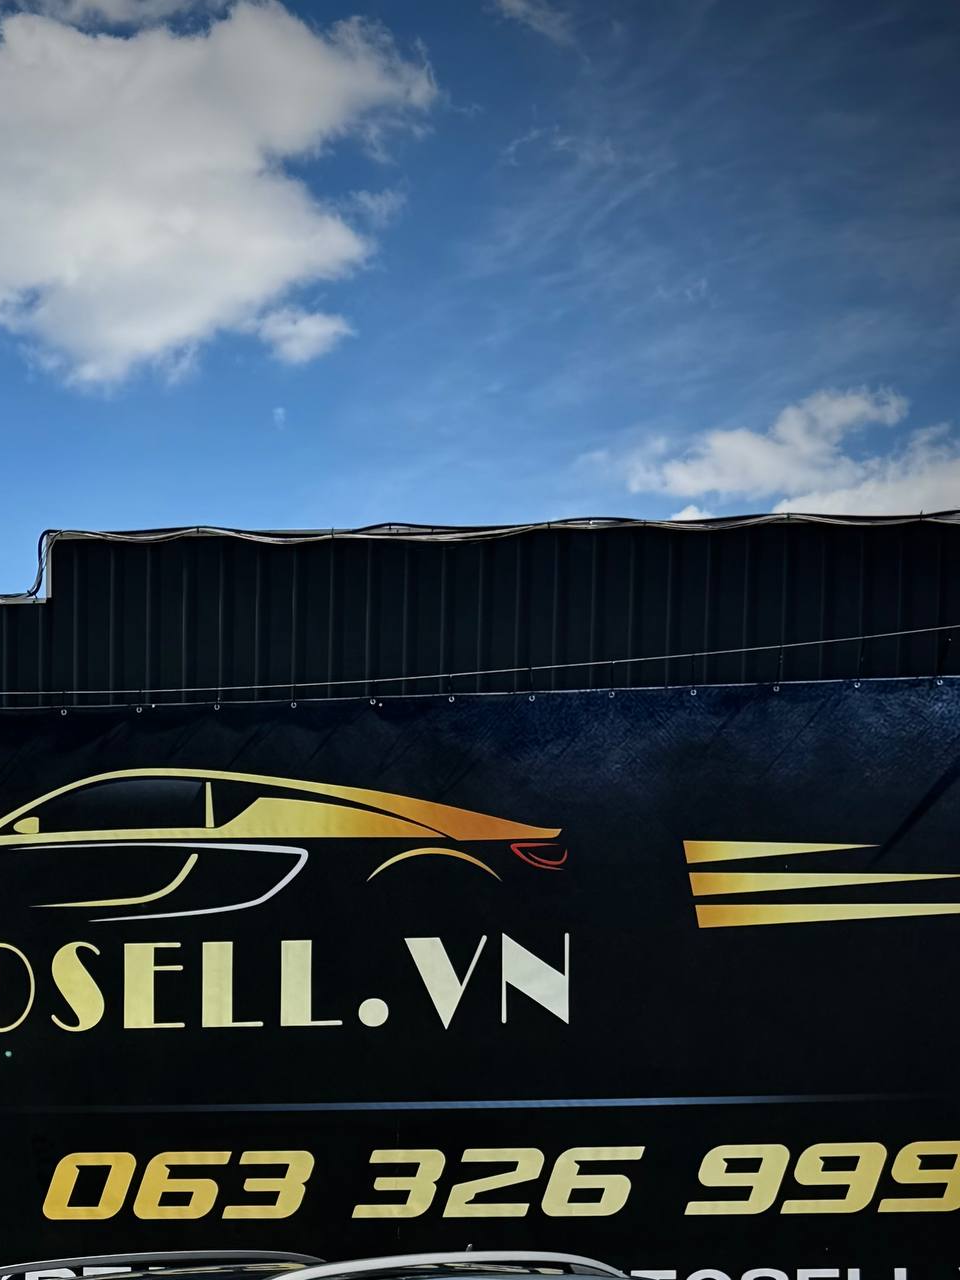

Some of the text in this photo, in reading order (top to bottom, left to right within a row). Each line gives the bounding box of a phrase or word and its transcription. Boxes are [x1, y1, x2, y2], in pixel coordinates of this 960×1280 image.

[43, 1141, 960, 1220] 063 326 999
